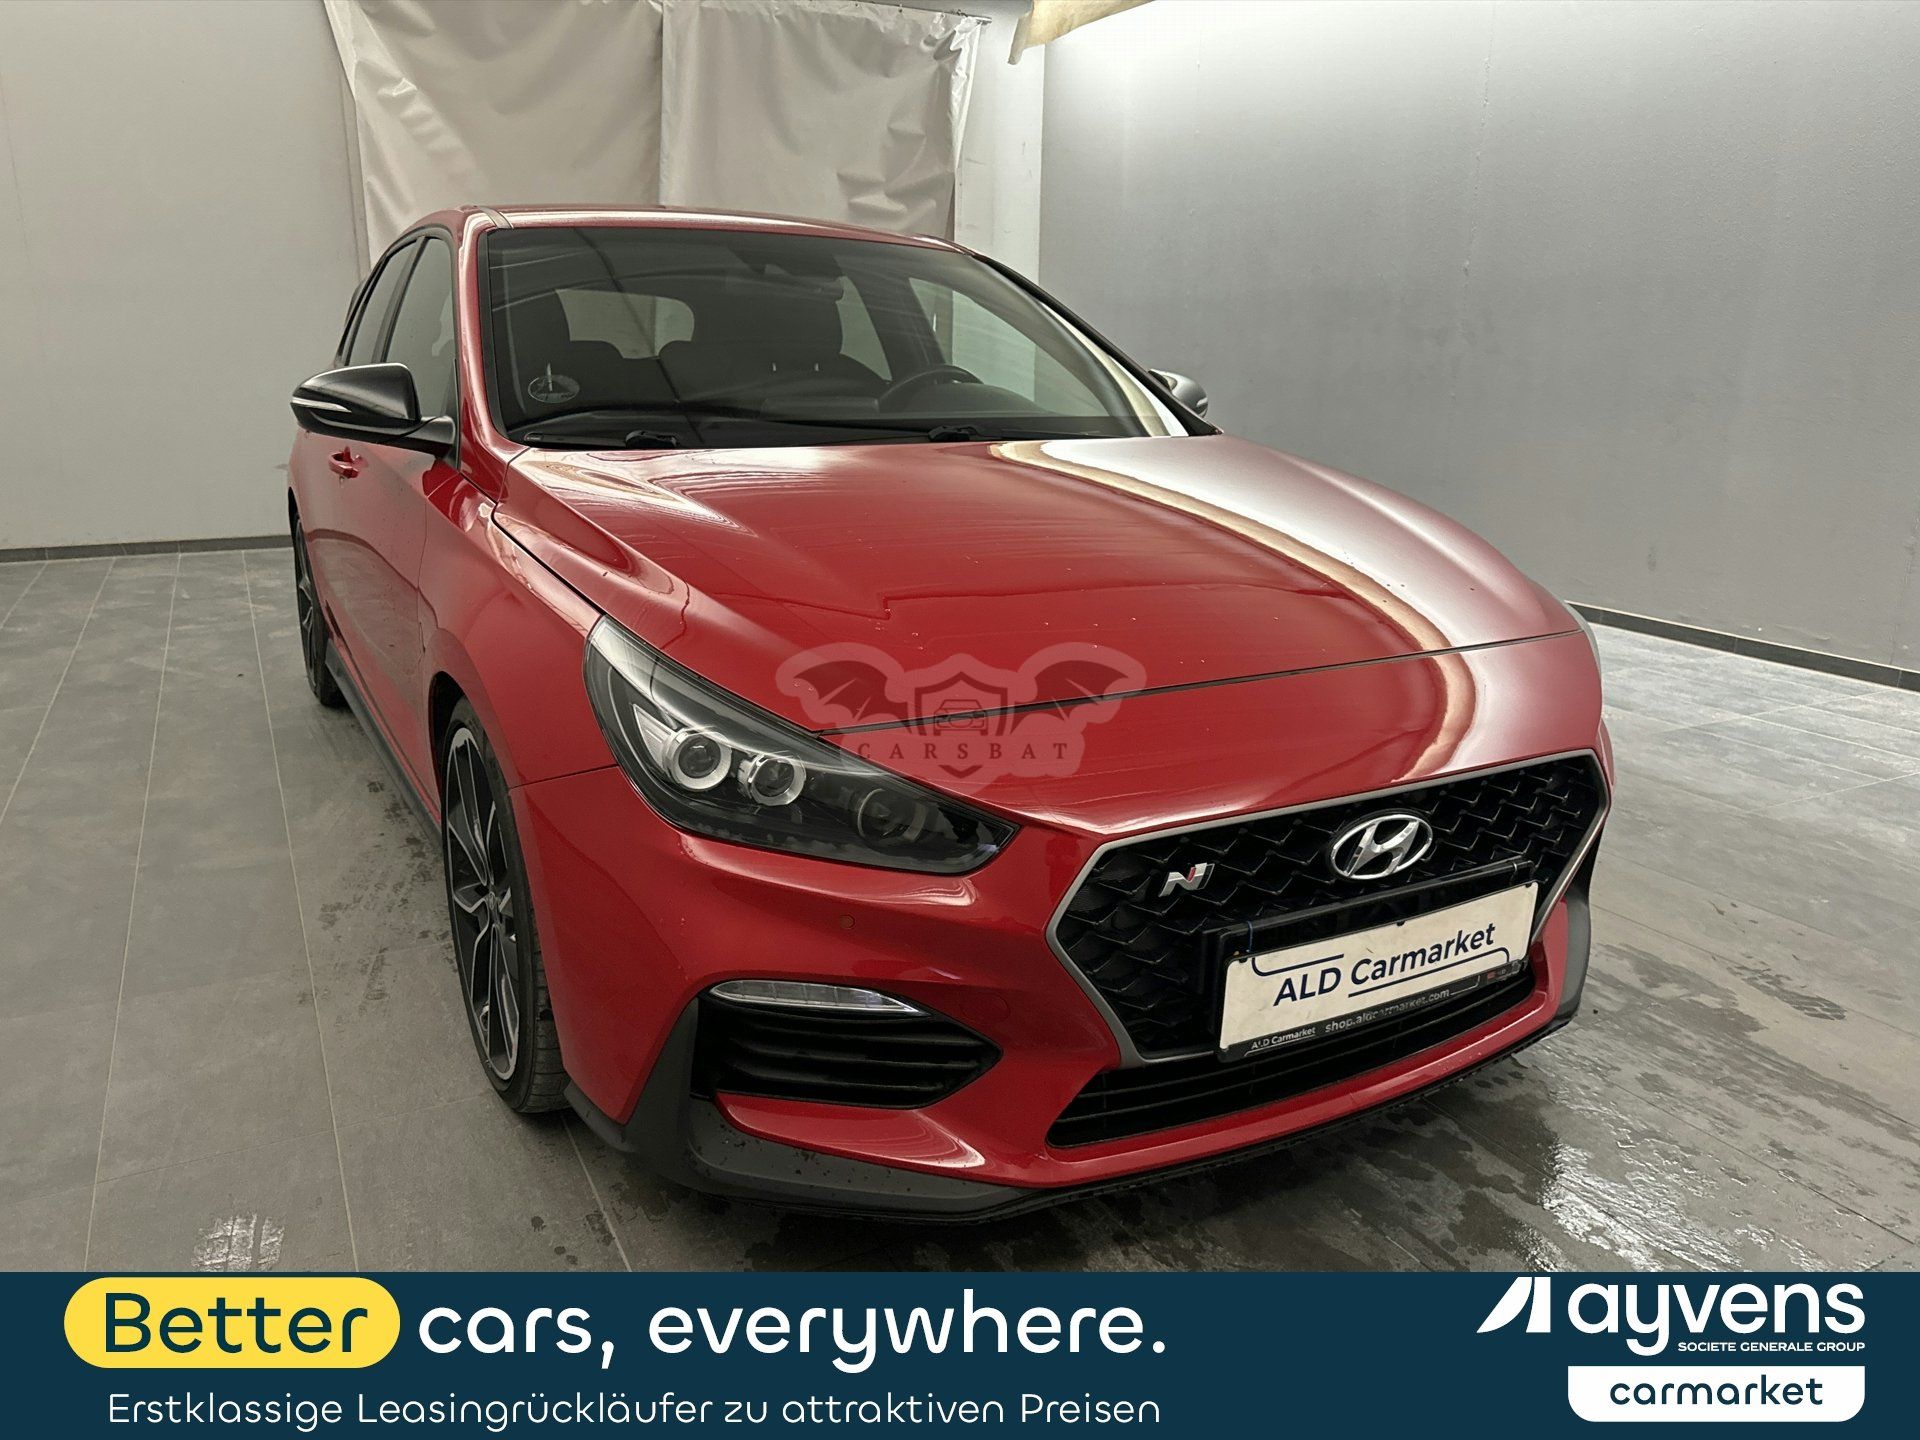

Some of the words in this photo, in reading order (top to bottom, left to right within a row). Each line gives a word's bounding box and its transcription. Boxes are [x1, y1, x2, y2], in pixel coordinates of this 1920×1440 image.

[1273, 967, 1341, 1006] ALD
[1351, 923, 1495, 985] Carmarket
[1271, 1026, 1316, 1044] Carmarket
